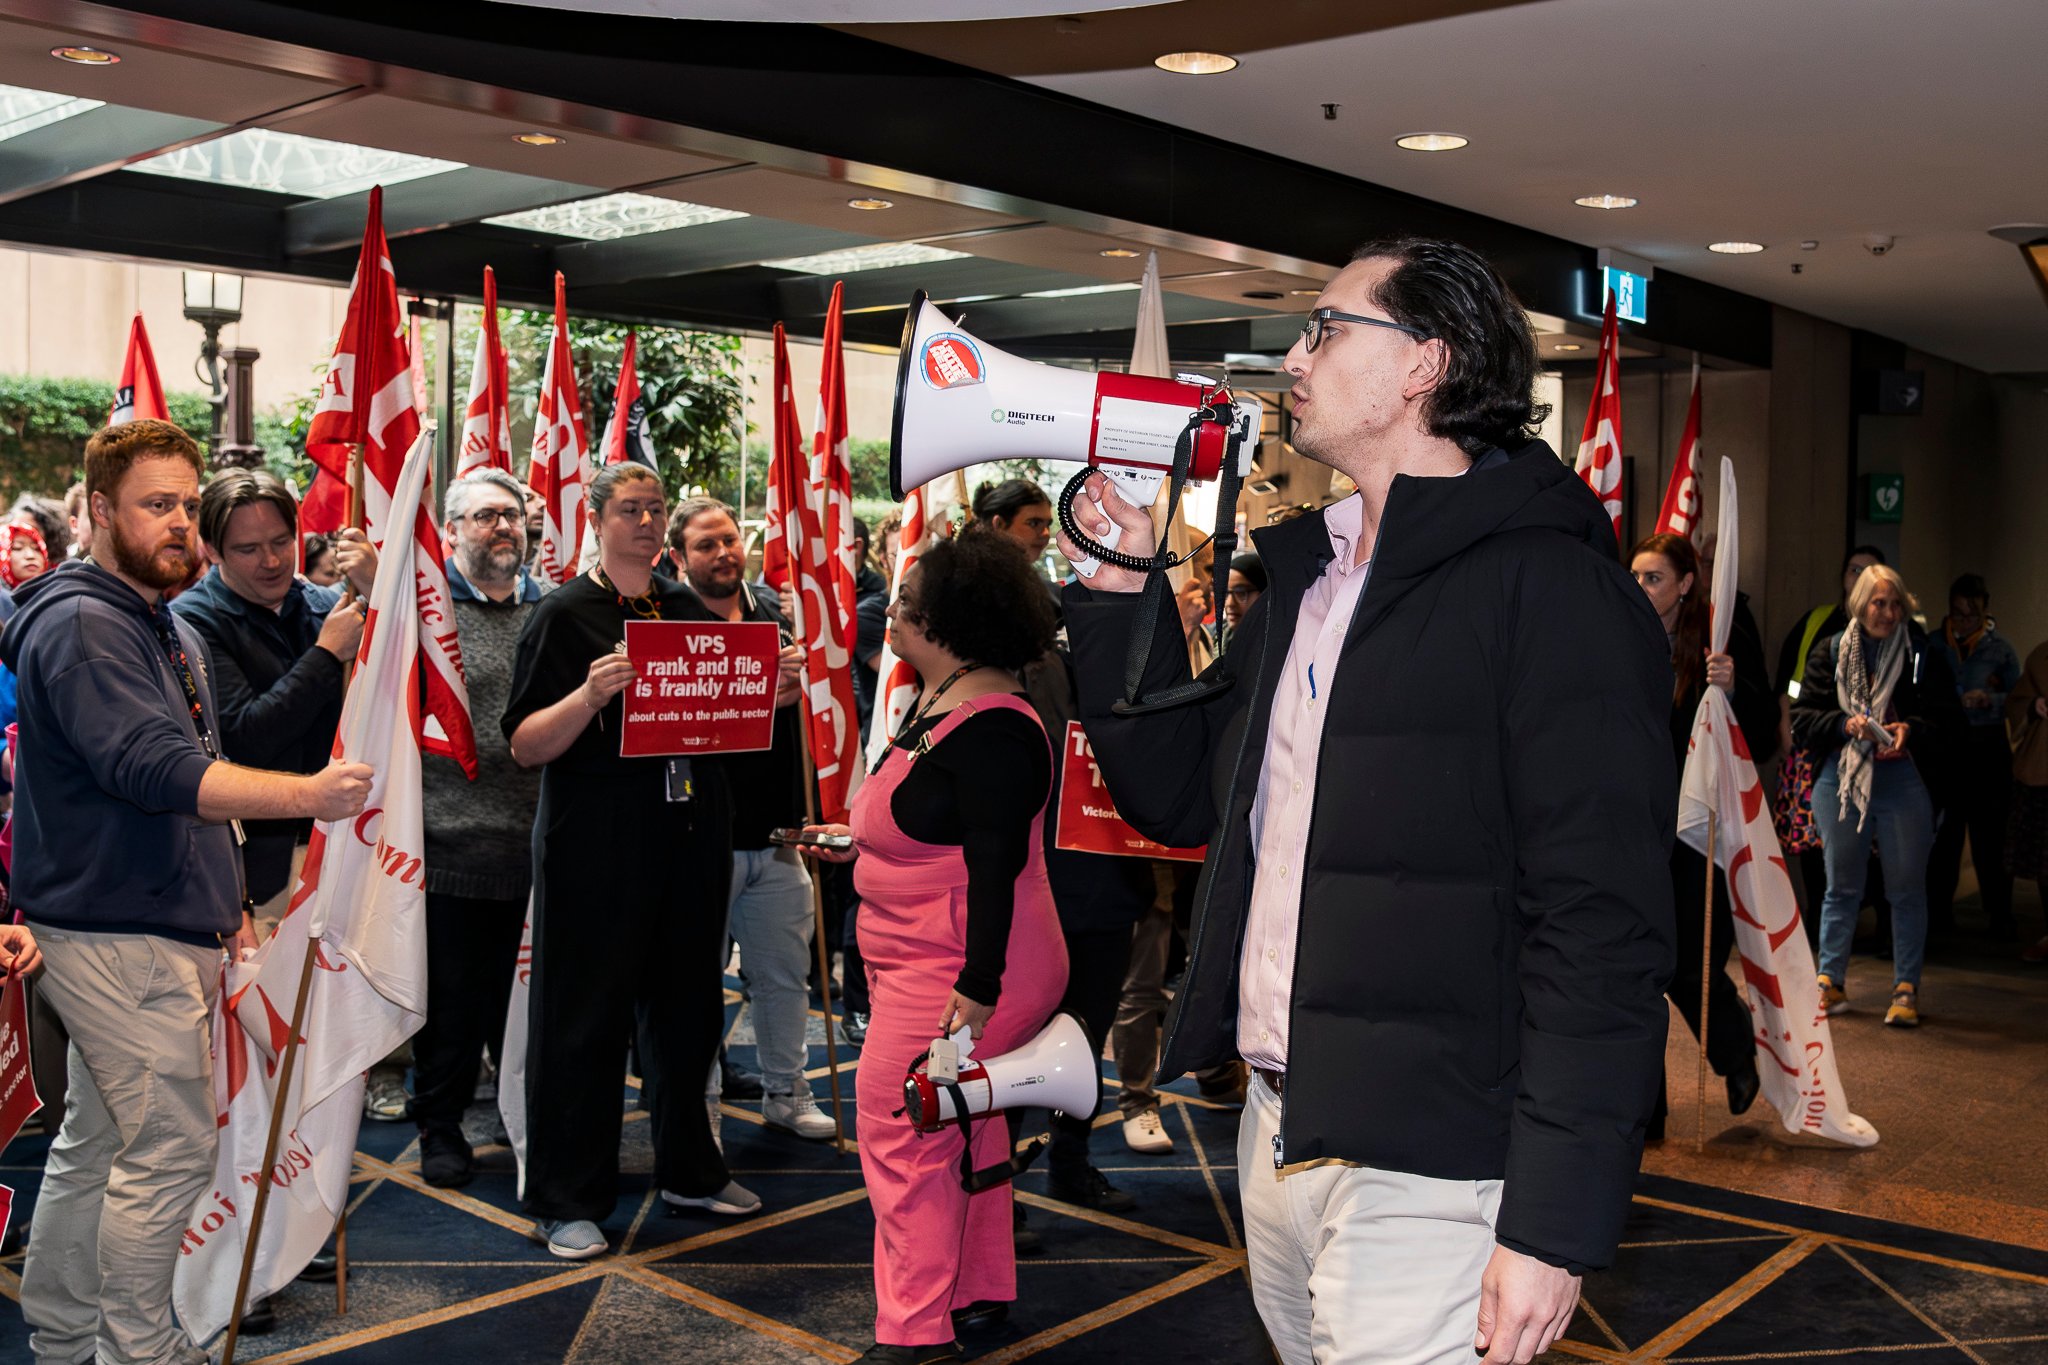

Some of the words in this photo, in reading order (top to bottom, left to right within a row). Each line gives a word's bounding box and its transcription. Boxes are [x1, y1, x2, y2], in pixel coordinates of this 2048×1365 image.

[1007, 418, 1026, 426] Audio
[1008, 410, 1055, 422] DIGITECH
[685, 635, 726, 654] VPS
[646, 656, 690, 676] rank
[695, 656, 728, 676] and
[734, 656, 762, 675] file
[635, 677, 653, 697] is
[659, 677, 723, 700] frankly
[727, 676, 767, 696] riled
[628, 711, 655, 722] about
[658, 710, 680, 721] cuts
[682, 711, 693, 721] to
[696, 709, 711, 720] the
[712, 708, 739, 722] public
[742, 708, 770, 719] sector
